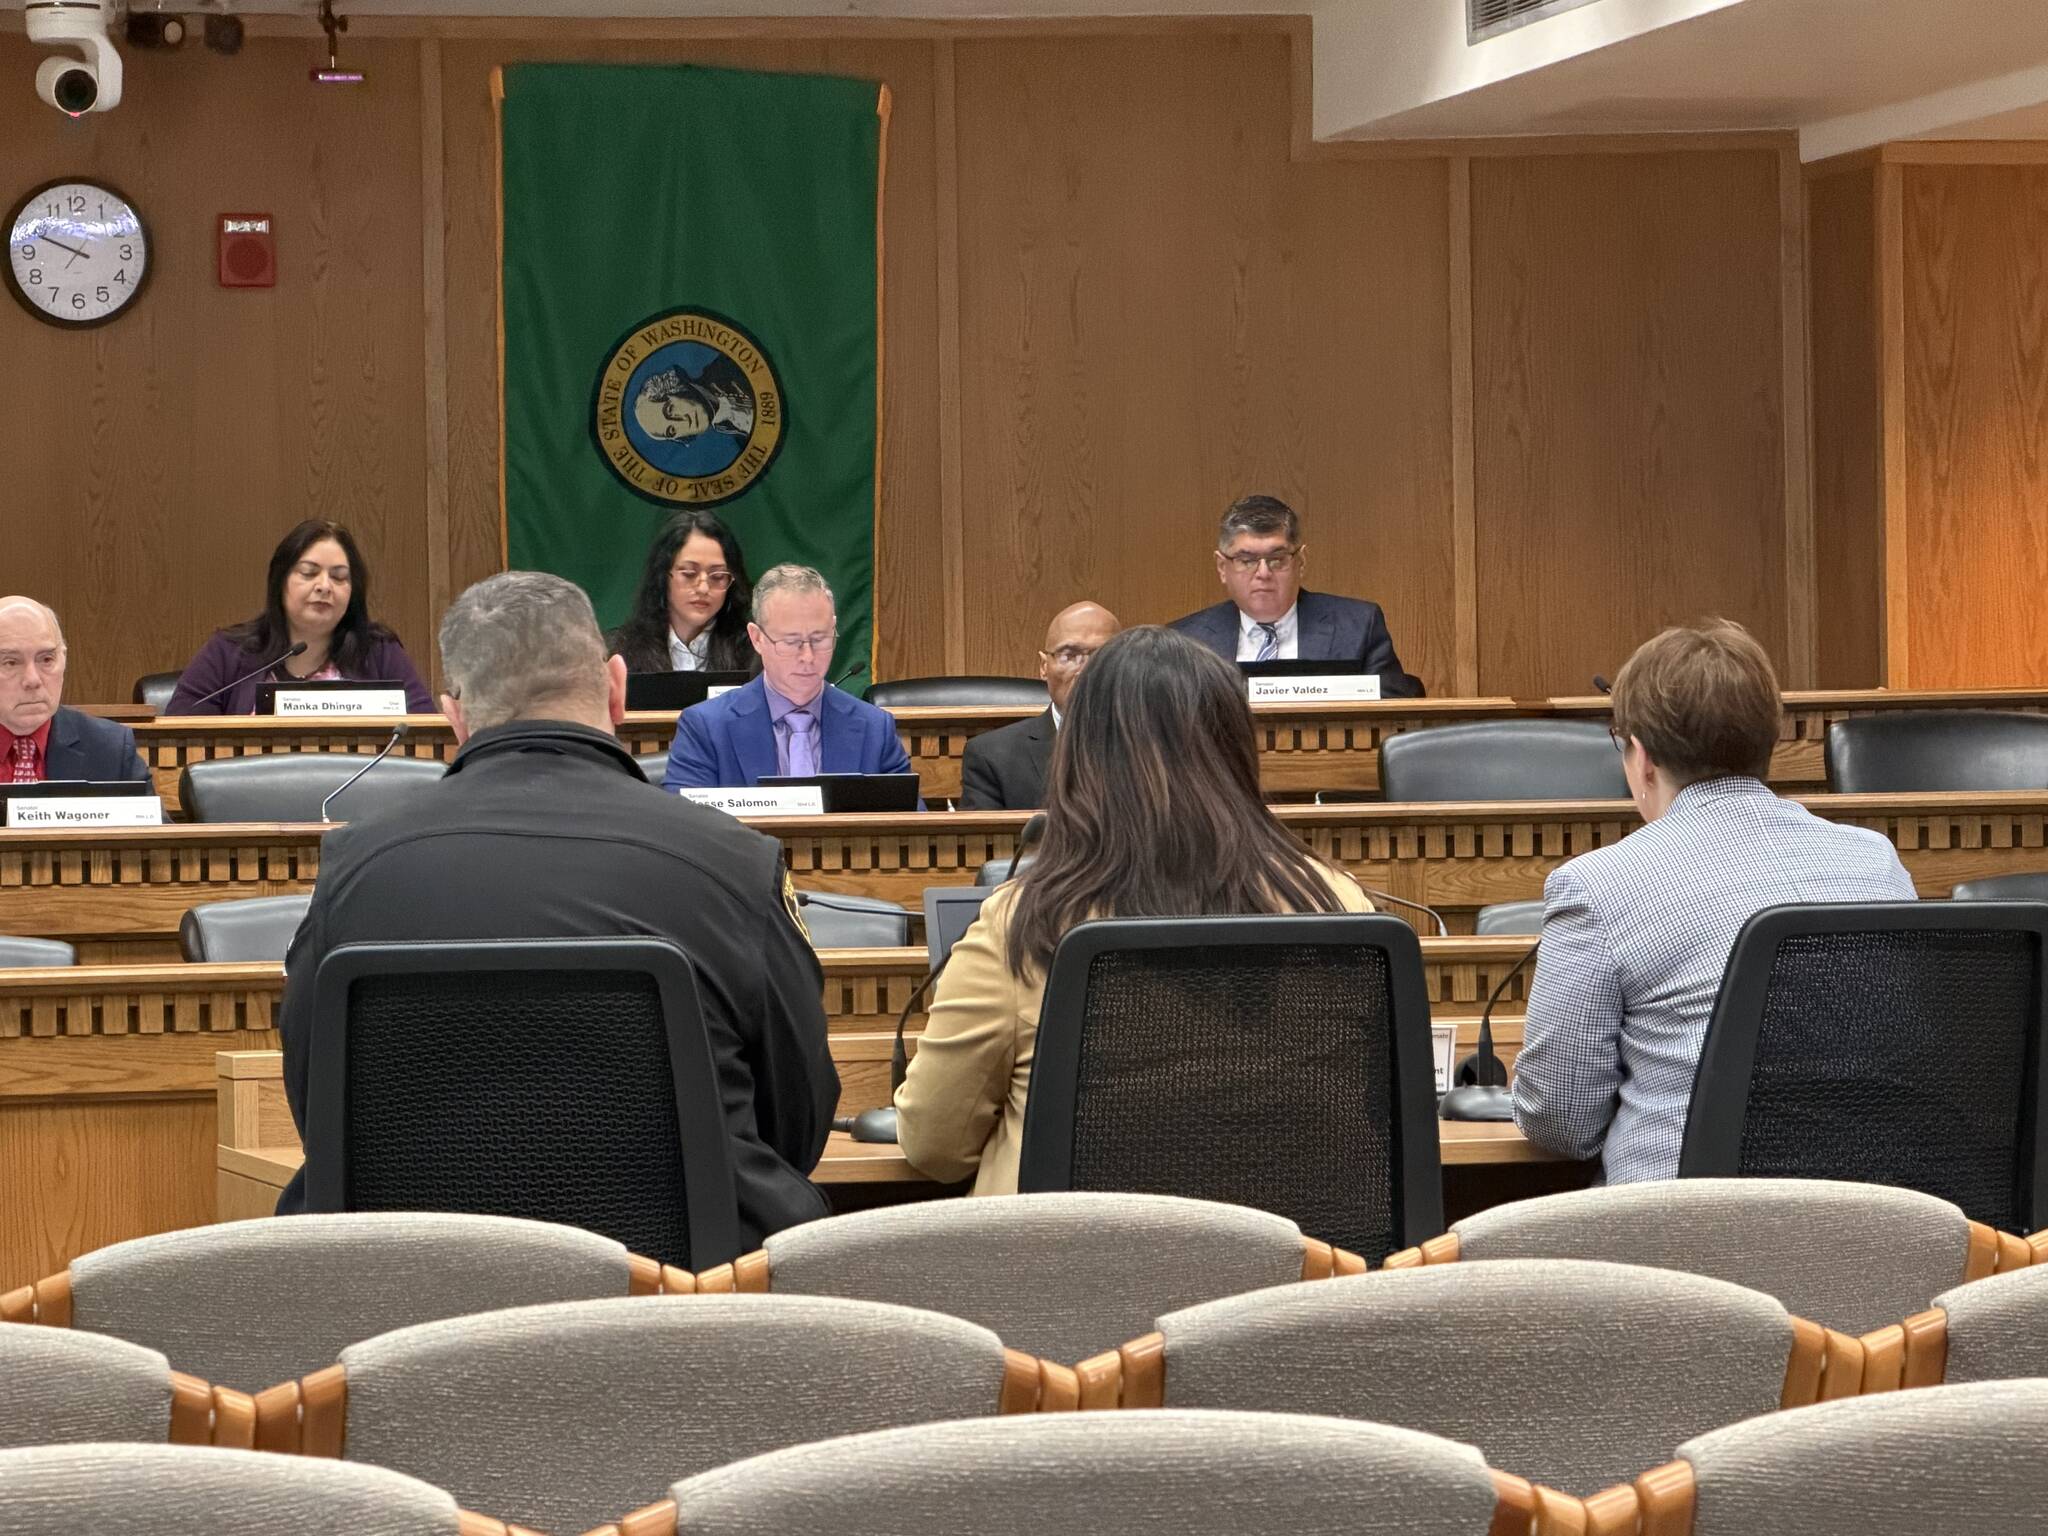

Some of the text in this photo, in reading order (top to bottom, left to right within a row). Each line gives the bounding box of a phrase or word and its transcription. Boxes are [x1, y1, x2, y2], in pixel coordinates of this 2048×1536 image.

[46, 203, 60, 217] 11
[67, 196, 86, 212] 12
[98, 203, 104, 219] 1
[22, 244, 36, 260] 9
[119, 244, 133, 260] 3
[29, 268, 42, 285] 8
[113, 268, 127, 285] 4
[48, 286, 60, 303] 7
[71, 293, 86, 309] 6
[96, 286, 110, 303] 5
[602, 319, 768, 499] THE SEAL OF THE STATE OF WASHINGTON
[759, 391, 776, 428] 1889
[1255, 686, 1329, 695] Javier Valdez
[283, 701, 363, 712] Manka Dhingra
[728, 798, 778, 808] Salomon
[17, 811, 110, 822] Keith Wagoner
